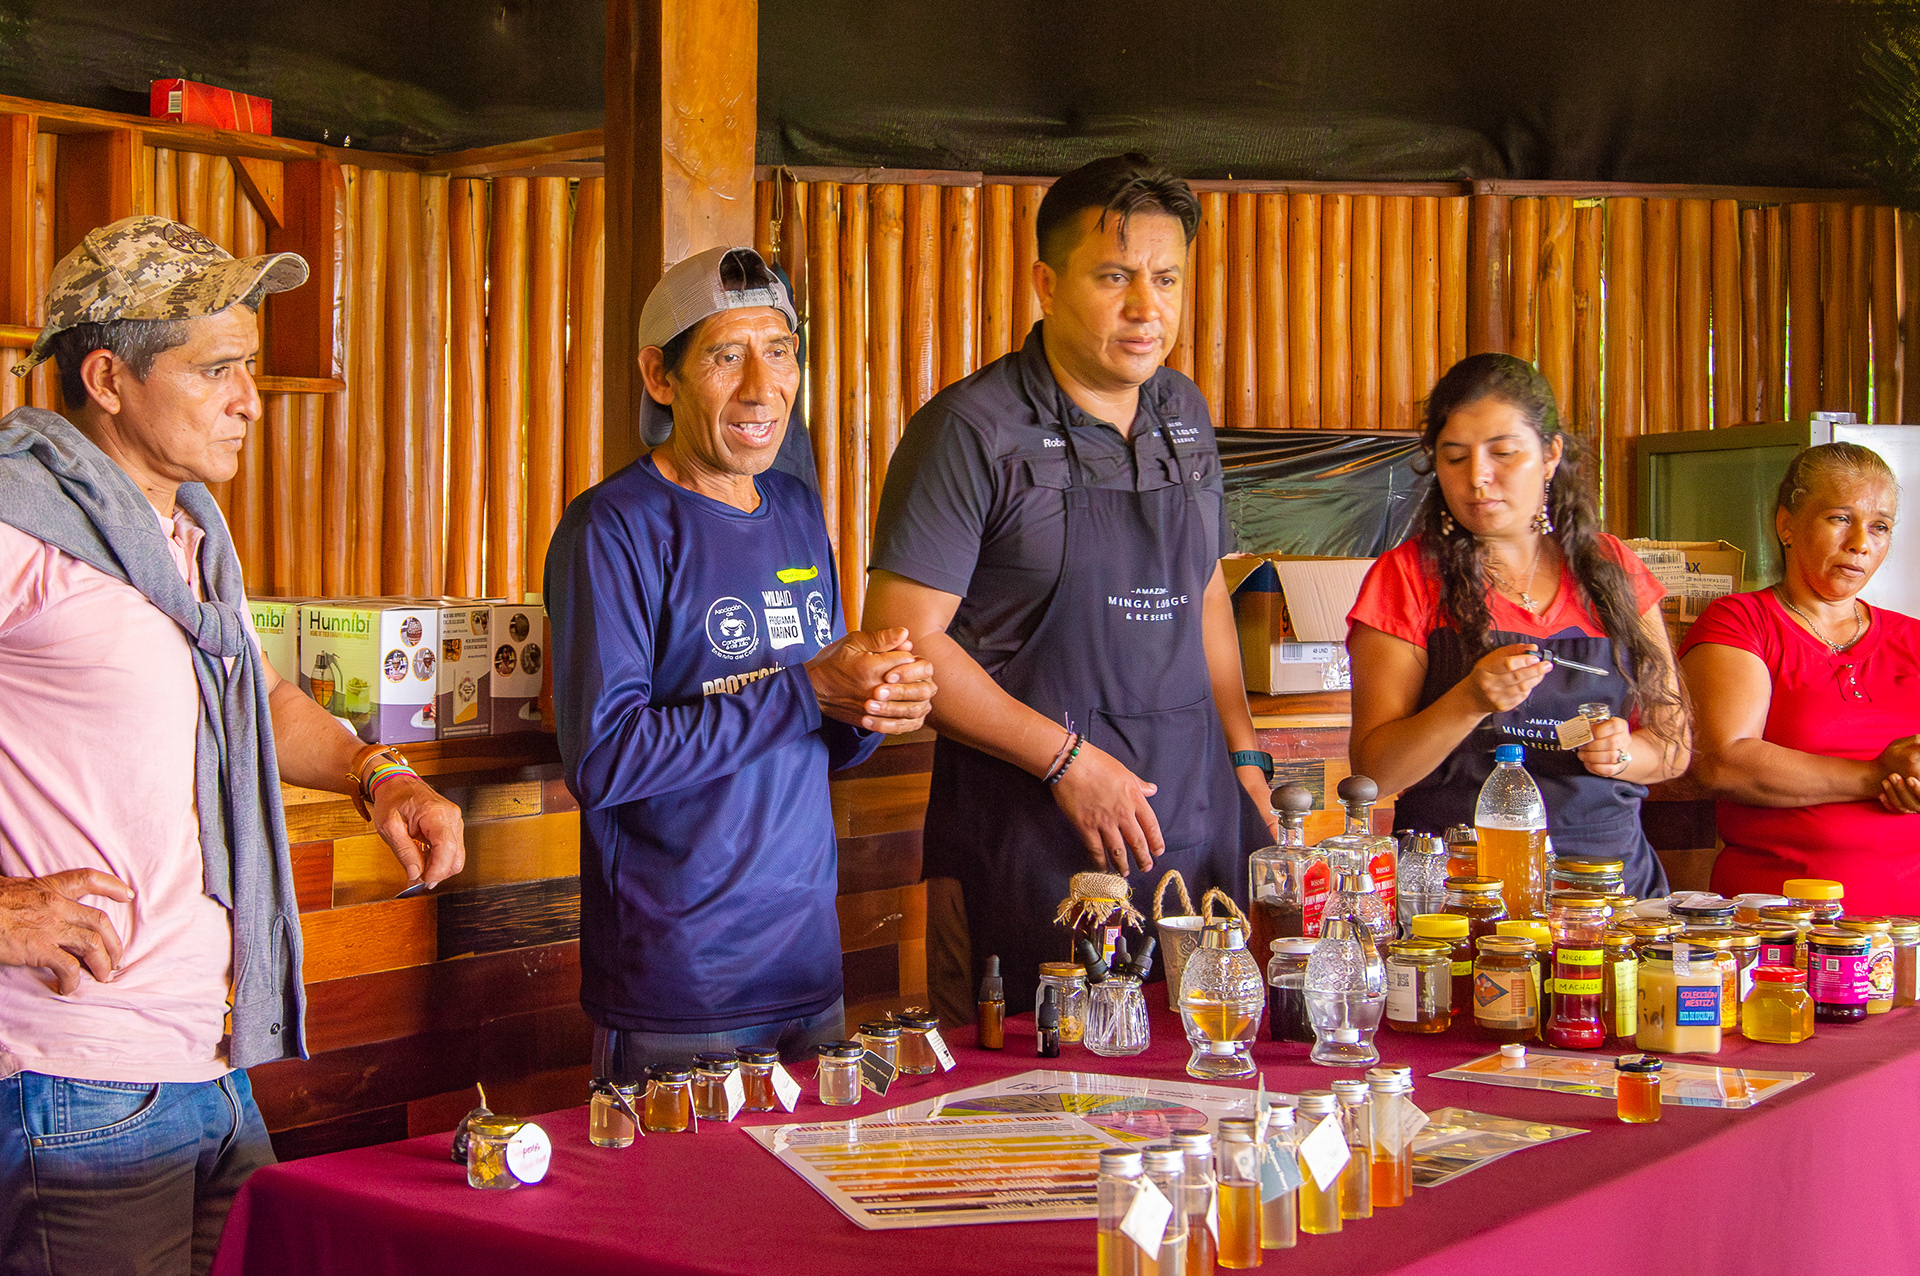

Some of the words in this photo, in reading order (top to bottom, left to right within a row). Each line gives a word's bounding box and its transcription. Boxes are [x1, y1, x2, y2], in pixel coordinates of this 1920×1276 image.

[761, 590, 793, 607] WILDAID
[1108, 595, 1152, 609] MINGA
[1155, 595, 1189, 609] LODGE
[715, 604, 742, 615] Asociación
[309, 611, 371, 633] Hunnibi
[768, 615, 797, 625] PROGRAMA
[1135, 612, 1174, 621] RESERVE
[770, 625, 799, 639] MARINO
[1502, 725, 1544, 739] MINGA
[1559, 983, 1599, 991] MACHALA
[1680, 989, 1718, 999] COLECCIÓN
[1684, 999, 1715, 1007] MESTIZA
[855, 1118, 962, 1131] ONNOISSEUR
[962, 1117, 1014, 1125] COLOR
